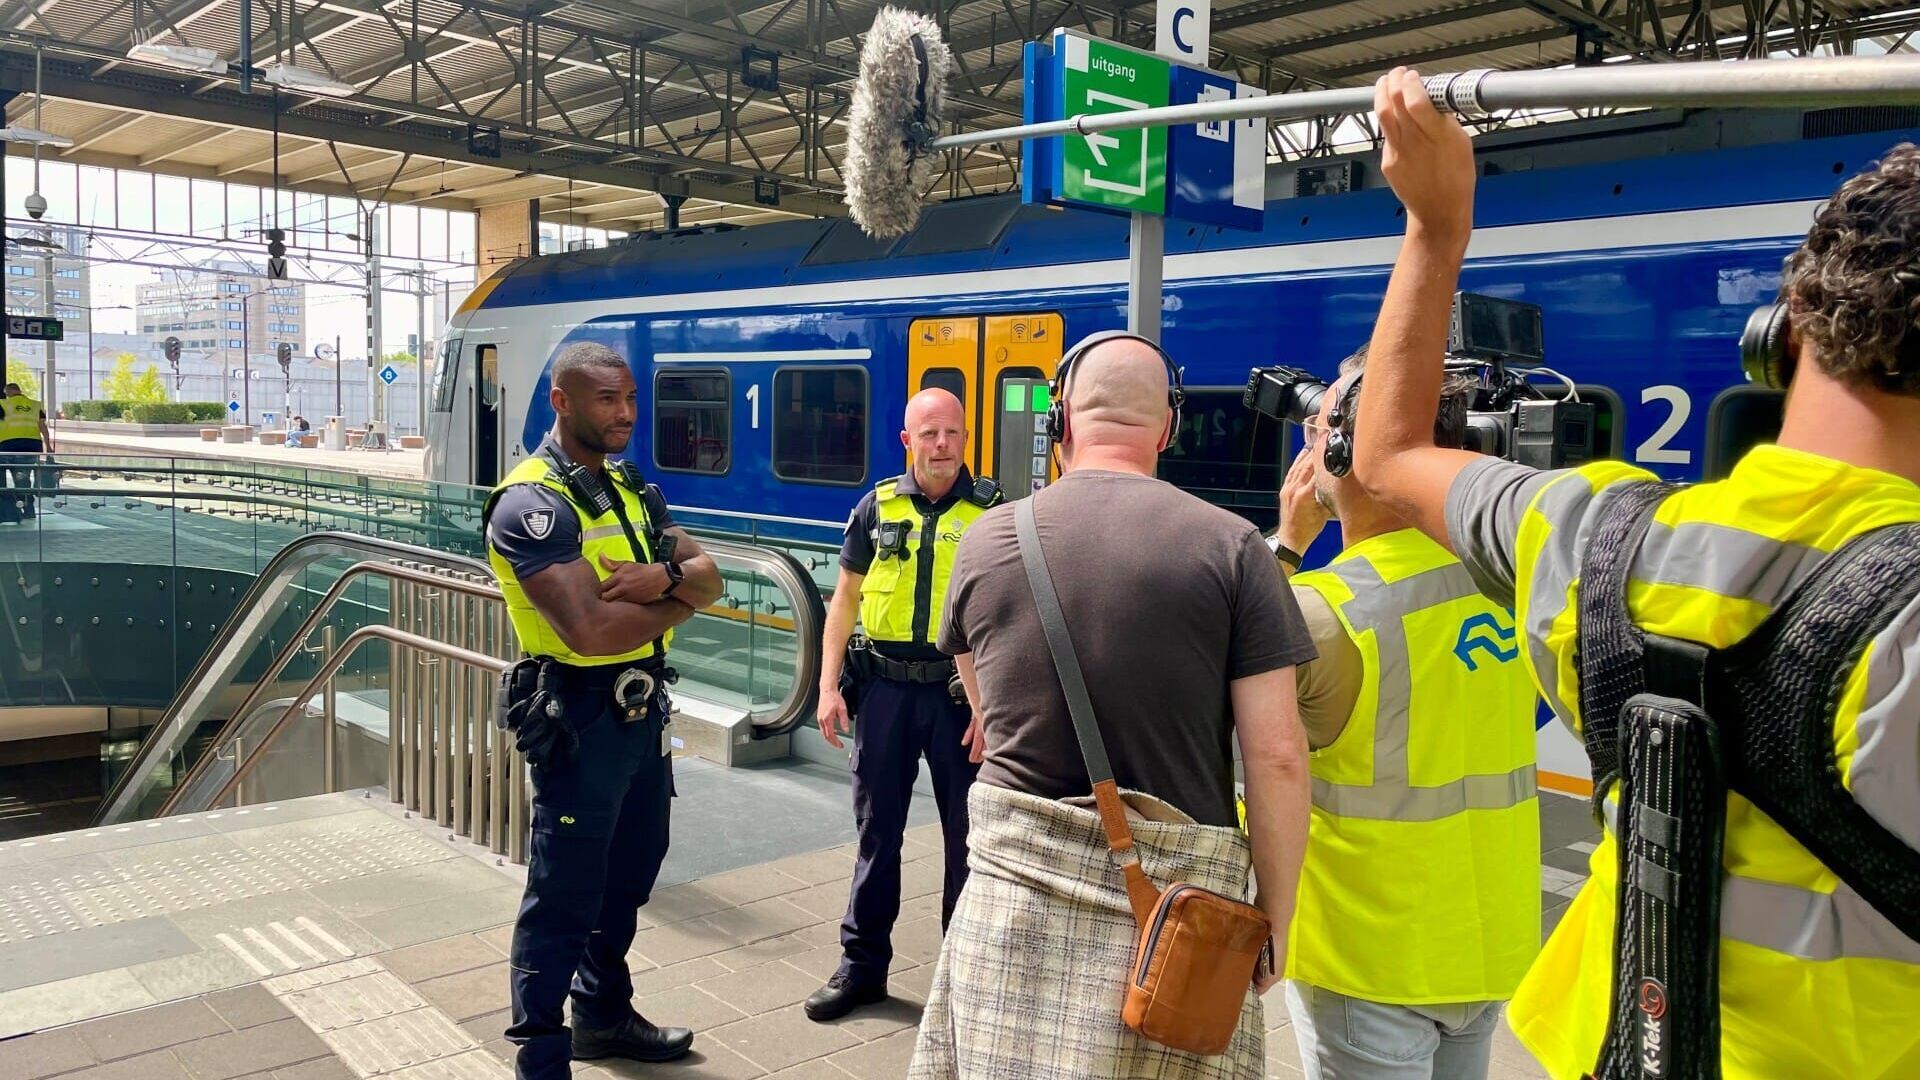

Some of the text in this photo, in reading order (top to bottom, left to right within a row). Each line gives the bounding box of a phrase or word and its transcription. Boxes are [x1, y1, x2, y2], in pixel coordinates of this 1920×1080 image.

[1173, 7, 1194, 54] C
[1092, 56, 1136, 82] uitgang
[746, 383, 759, 429] 1
[1636, 385, 1691, 464] 2
[1643, 1013, 1661, 1075] K-Tek
